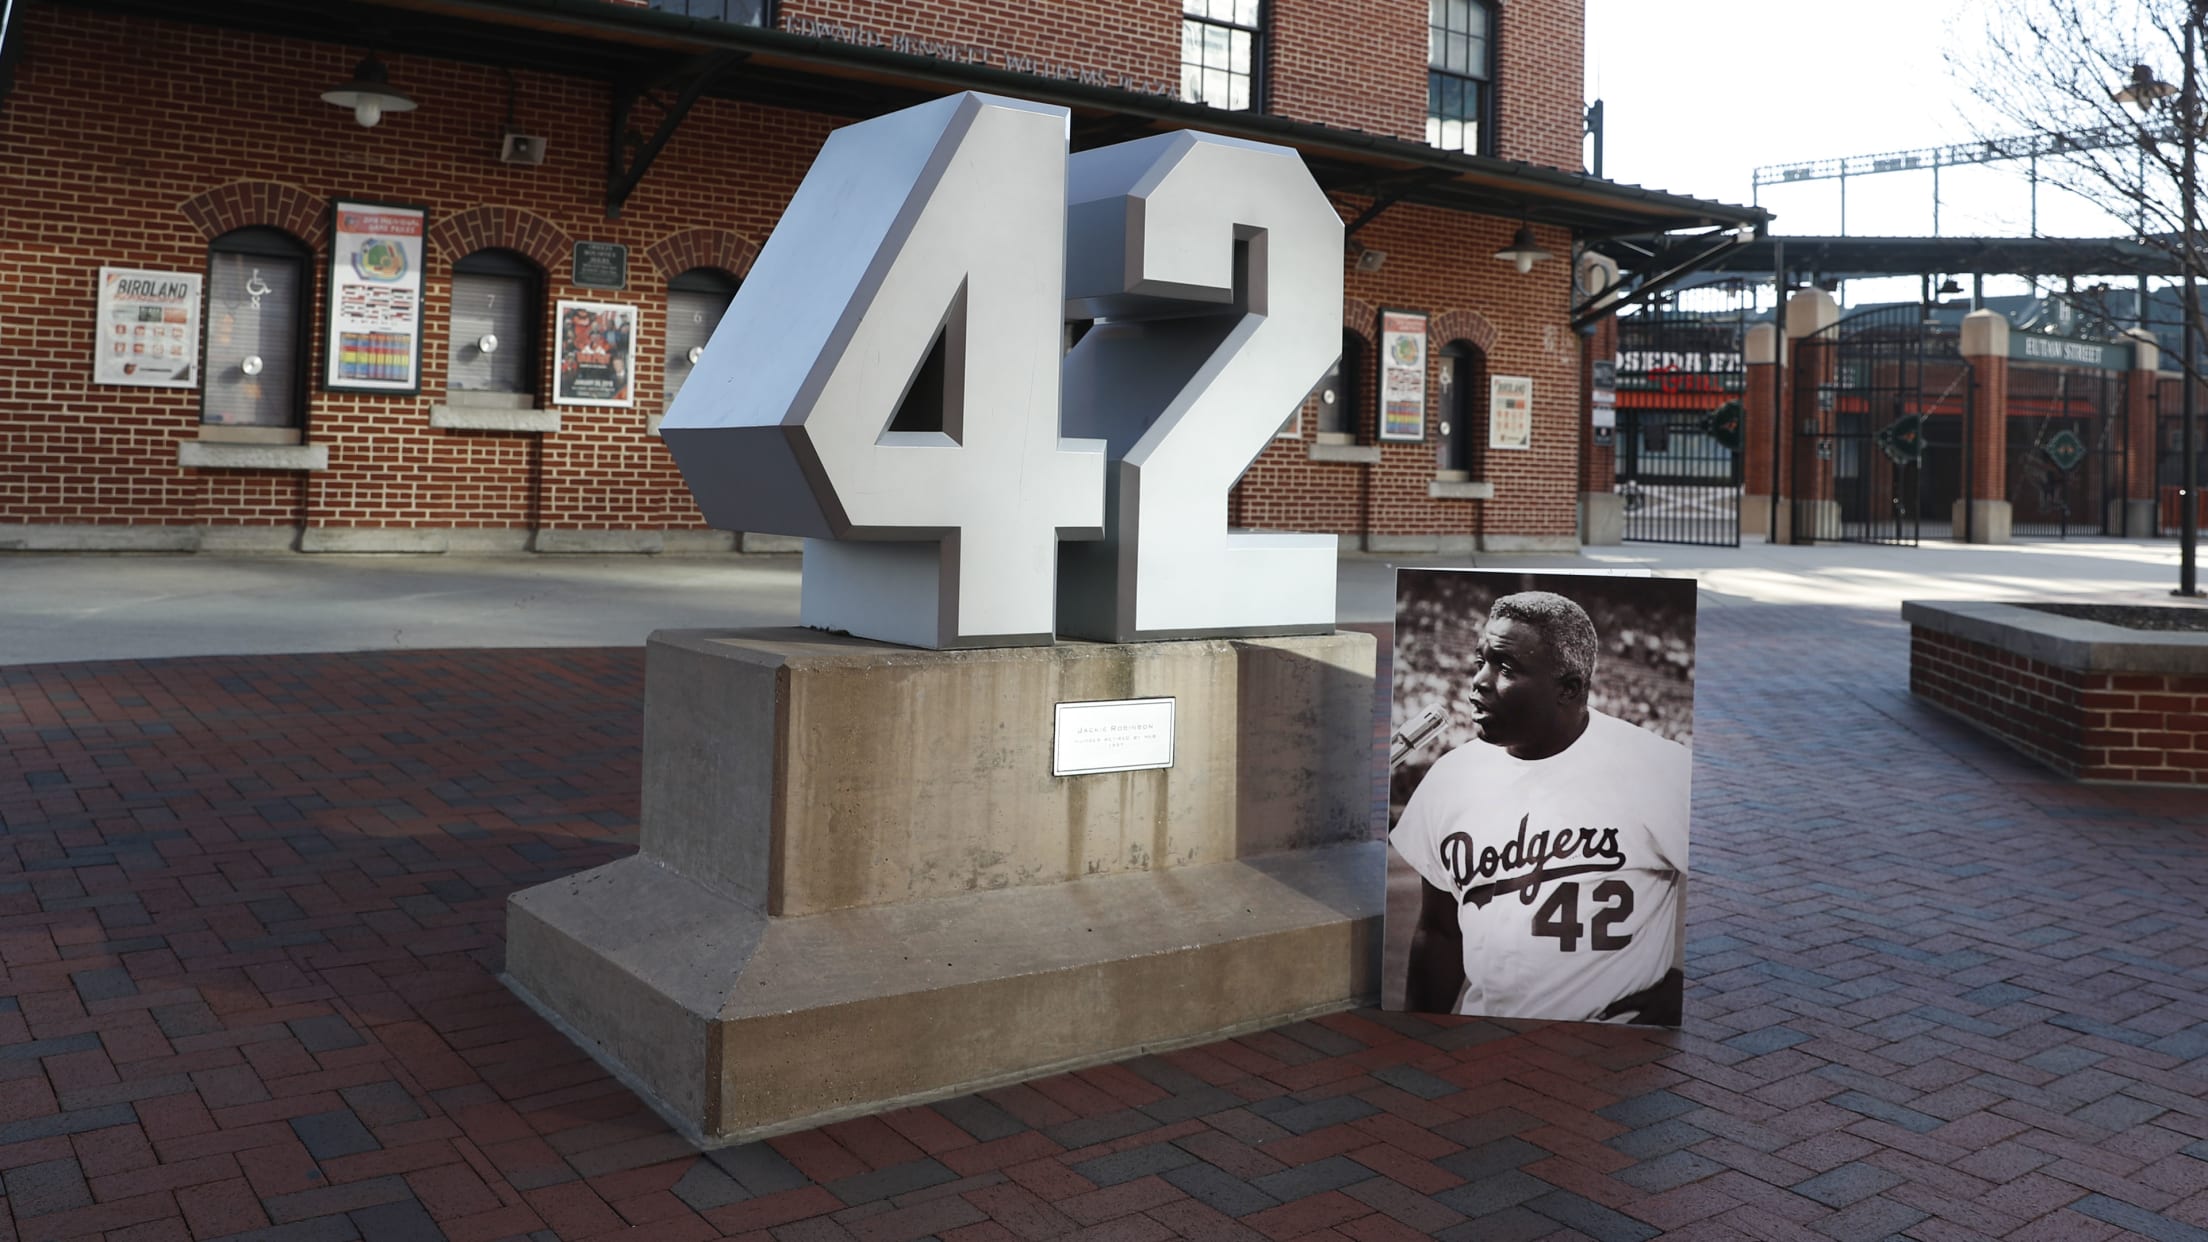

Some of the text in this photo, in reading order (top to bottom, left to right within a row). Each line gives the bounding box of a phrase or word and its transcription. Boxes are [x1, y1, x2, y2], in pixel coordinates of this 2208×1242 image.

[785, 16, 1181, 101] EDWARD BENNETT WILLIAMS PLAZA
[117, 279, 188, 298] BIRDLAND
[487, 294, 496, 309] 7
[693, 310, 703, 325] 6
[2025, 336, 2103, 365] EUTAW STREET
[660, 90, 1345, 650] 42
[1077, 723, 1154, 734] JACKIE ROBINSON
[1440, 813, 1626, 905] Dodgers
[1531, 880, 1634, 953] 42
